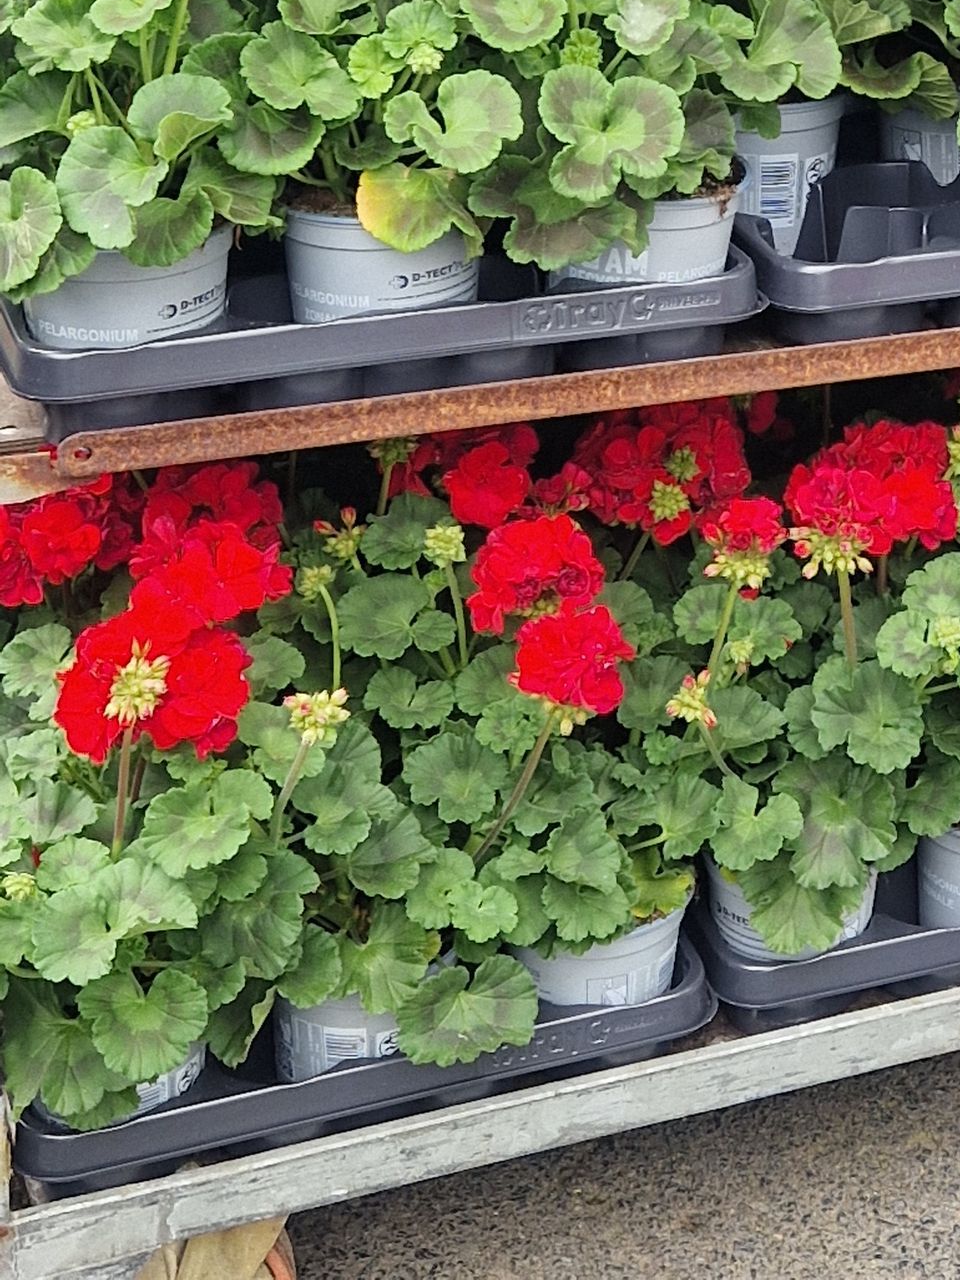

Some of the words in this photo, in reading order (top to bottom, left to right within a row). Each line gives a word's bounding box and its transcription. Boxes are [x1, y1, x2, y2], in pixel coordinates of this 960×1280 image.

[411, 263, 454, 283] D-TECT
[604, 247, 650, 276] AM
[179, 288, 216, 312] D-TECT
[38, 320, 139, 343] PELARGONIUM
